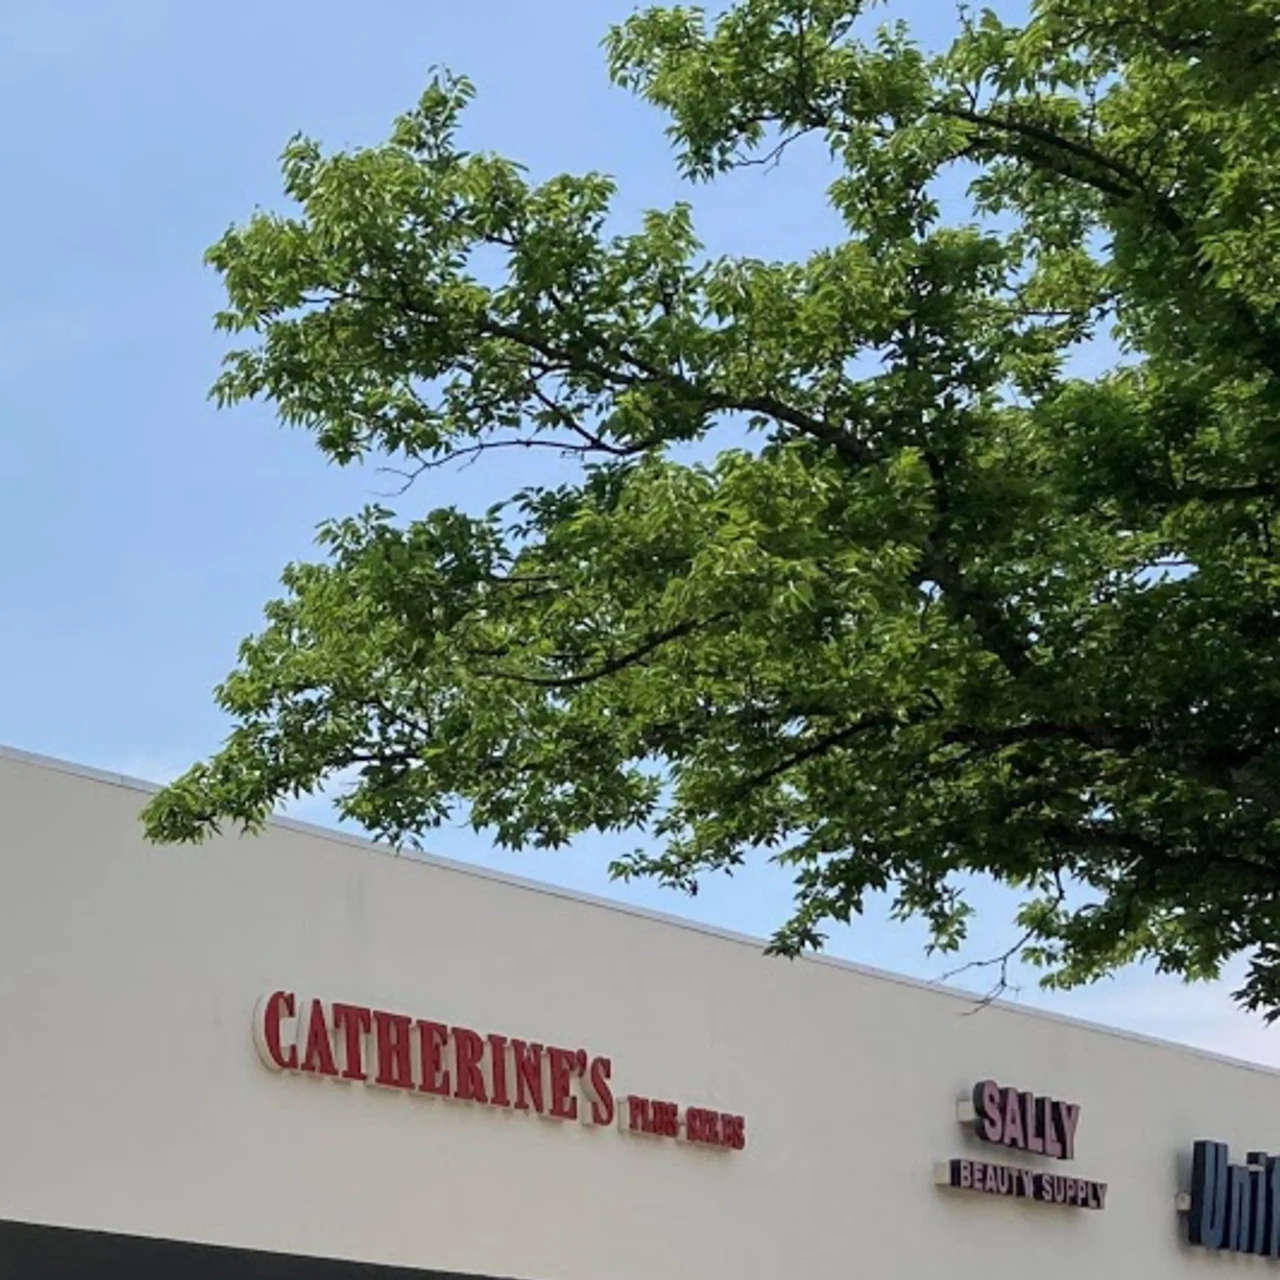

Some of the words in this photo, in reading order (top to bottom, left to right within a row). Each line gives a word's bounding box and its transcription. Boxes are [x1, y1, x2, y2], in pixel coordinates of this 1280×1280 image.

[257, 991, 615, 1127] CATHERINE'S
[973, 1080, 1080, 1160] SALLY
[953, 1159, 1036, 1200] BEAUTY
[1037, 1173, 1108, 1210] SUPPLY
